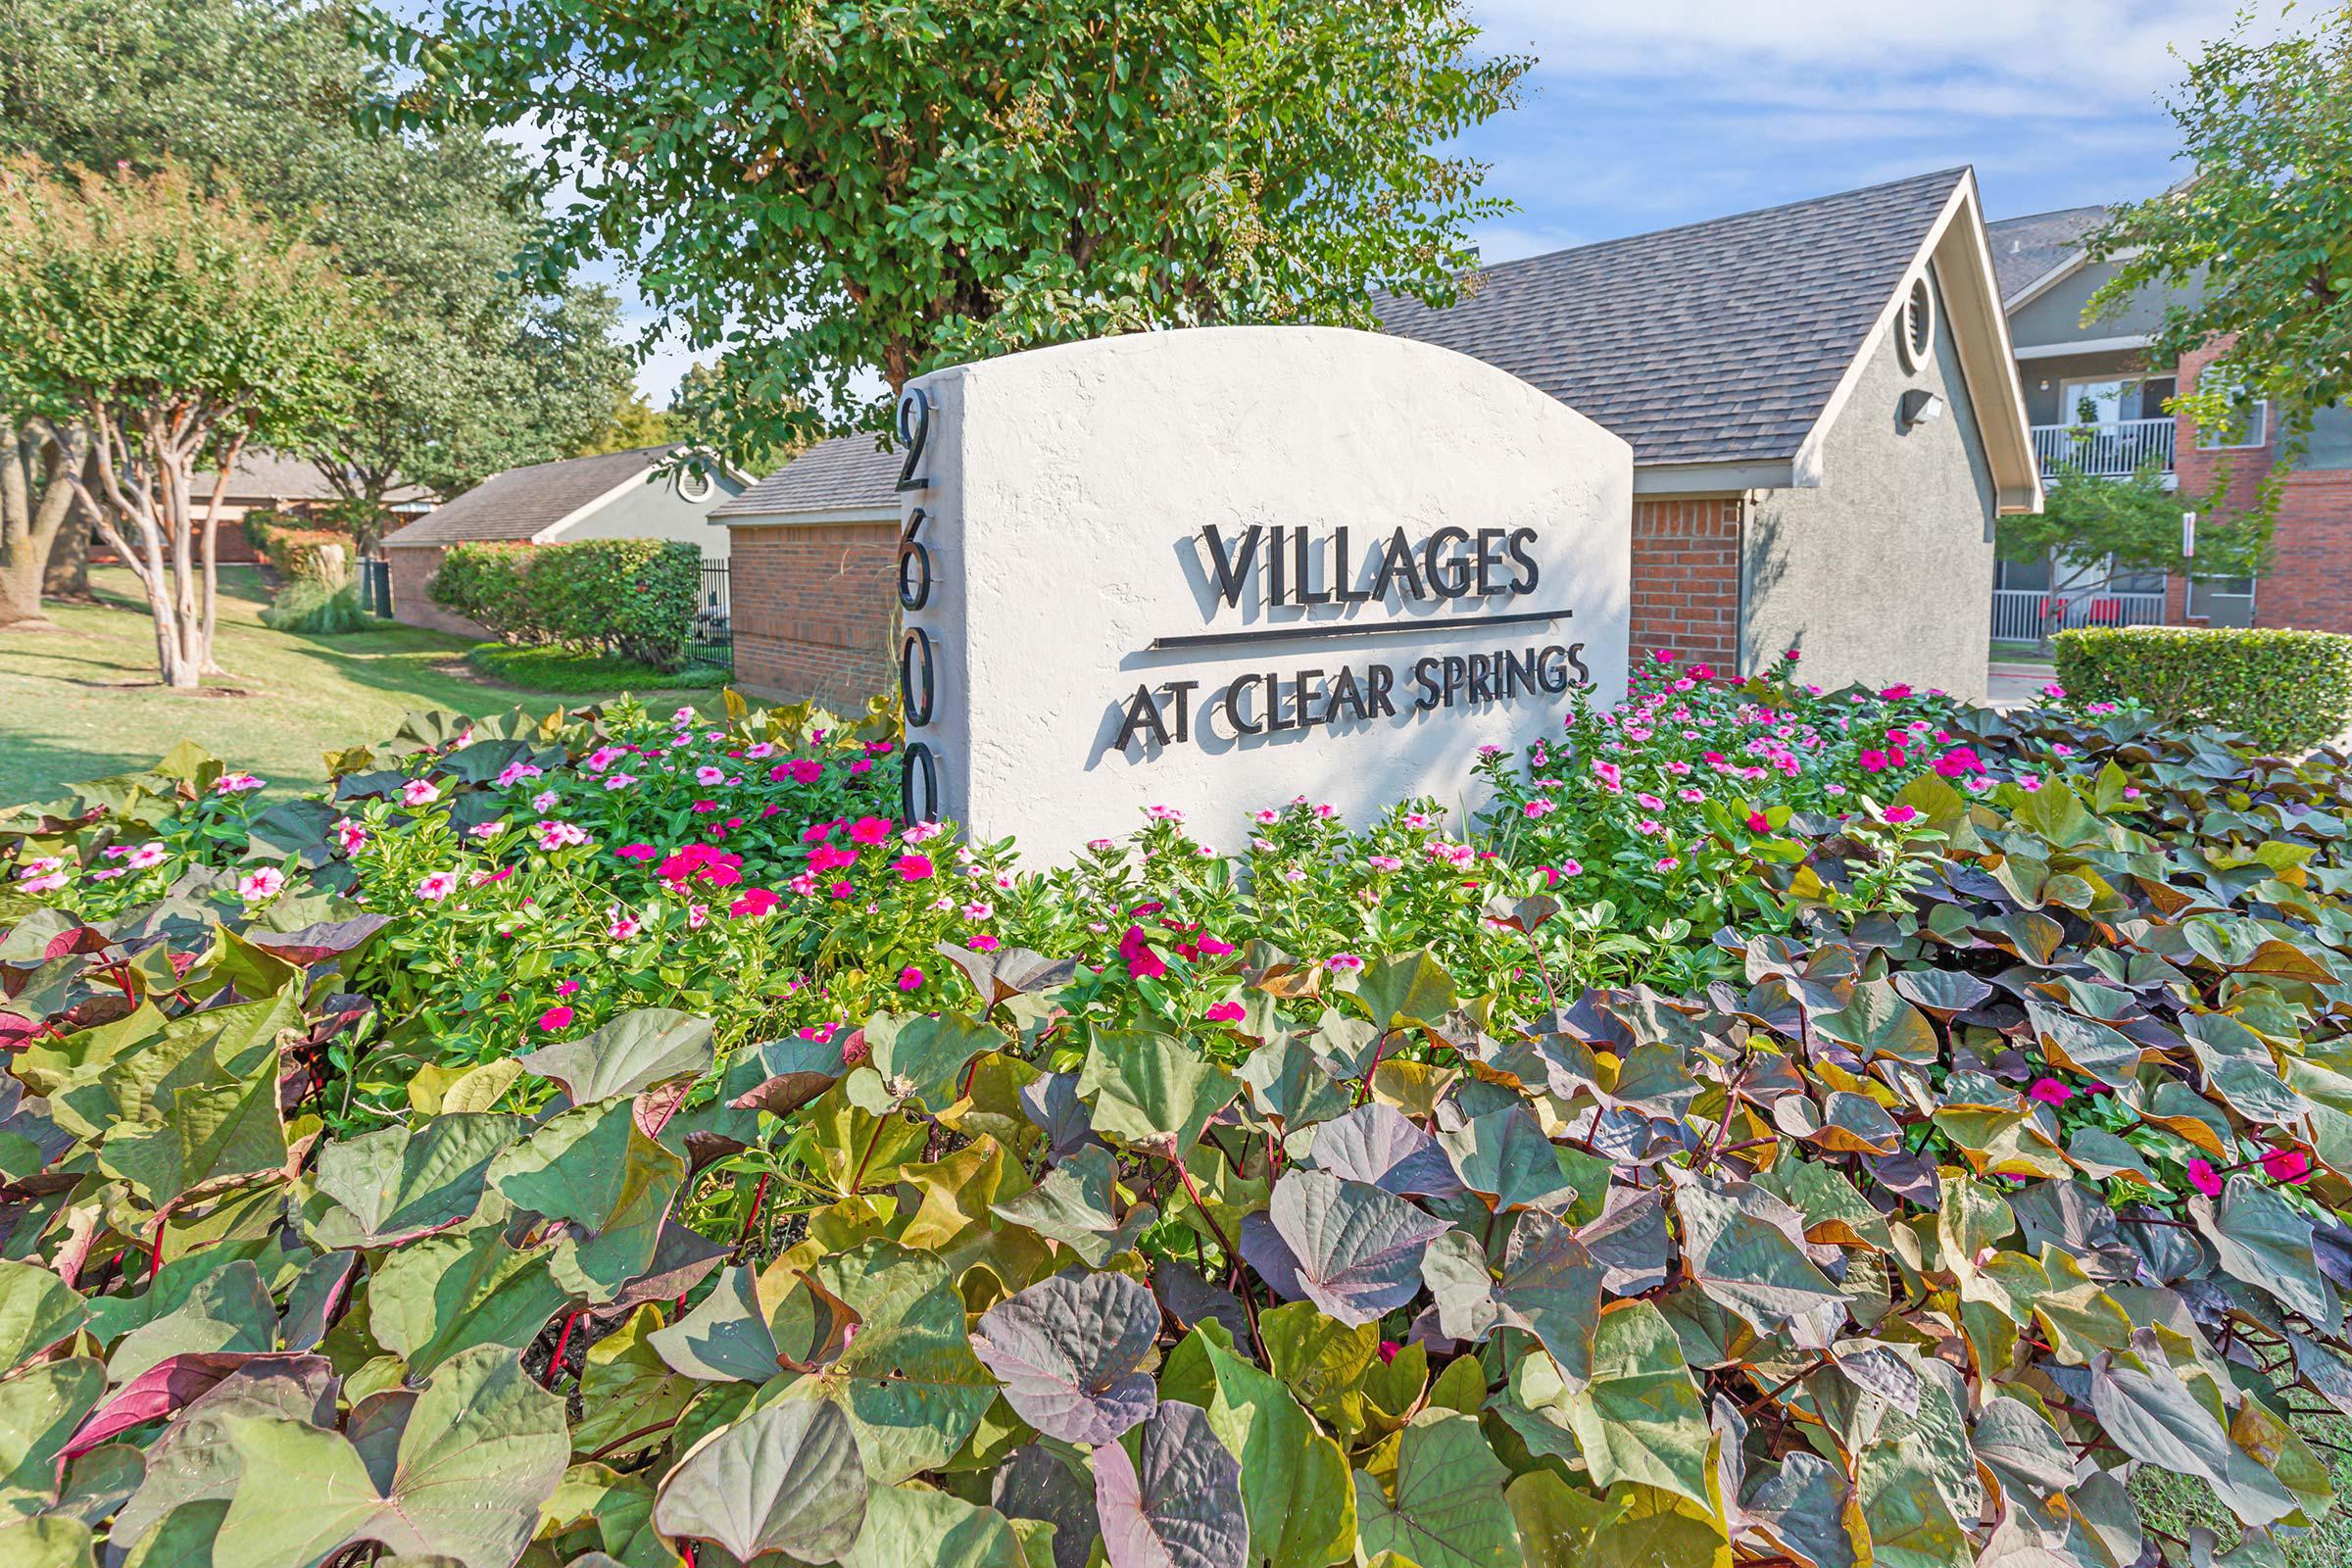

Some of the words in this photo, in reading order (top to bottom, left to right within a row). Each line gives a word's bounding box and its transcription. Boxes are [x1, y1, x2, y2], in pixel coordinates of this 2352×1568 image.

[895, 387, 938, 828] 2600
[1201, 523, 1539, 608] VILLAGES
[1114, 680, 1199, 751] AT
[1225, 663, 1396, 734] CLEAR
[1414, 643, 1589, 710] SPRINGS
